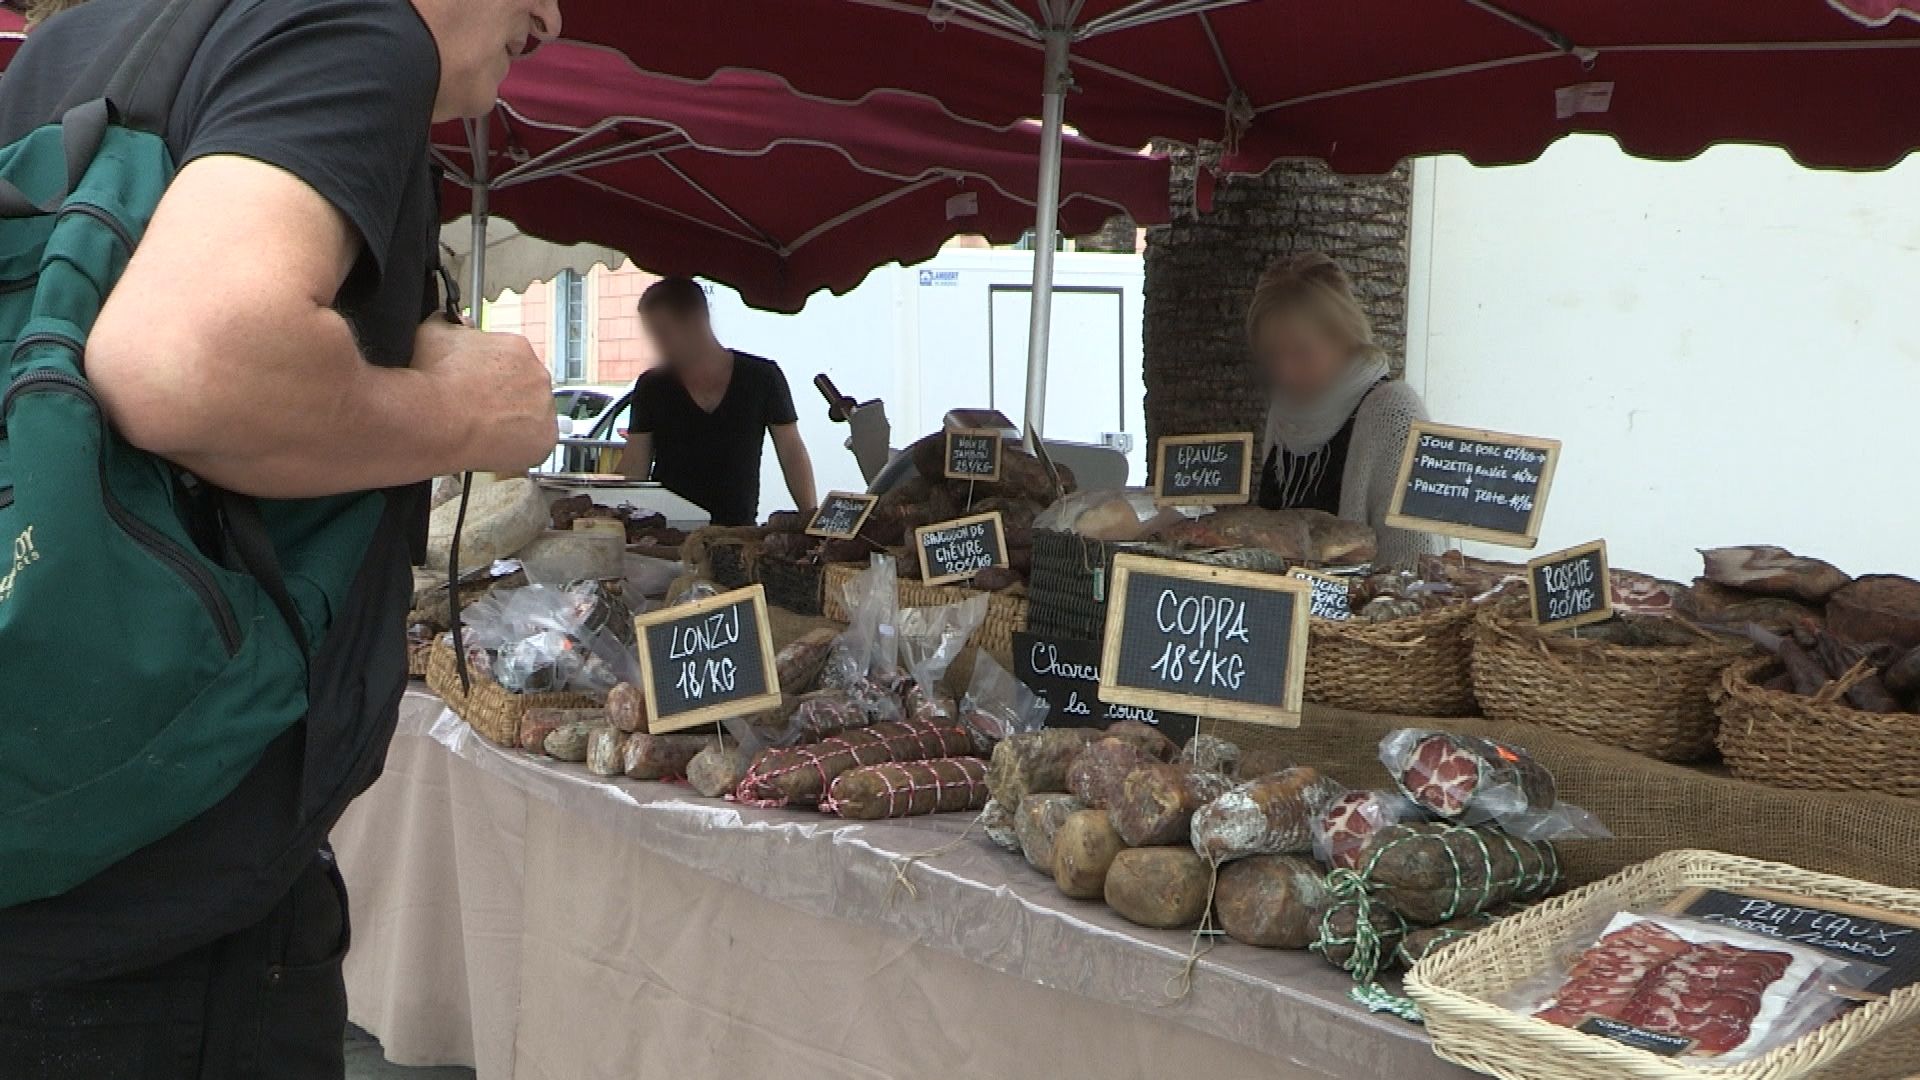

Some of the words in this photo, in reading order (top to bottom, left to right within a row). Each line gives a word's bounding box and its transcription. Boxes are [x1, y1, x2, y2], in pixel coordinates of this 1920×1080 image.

[1156, 589, 1250, 650] COPPA
[675, 657, 738, 700] 18/KG
[1150, 641, 1247, 691] 18€/KG
[1063, 691, 1091, 716] la
[1739, 899, 1914, 943] PLATEAUX
